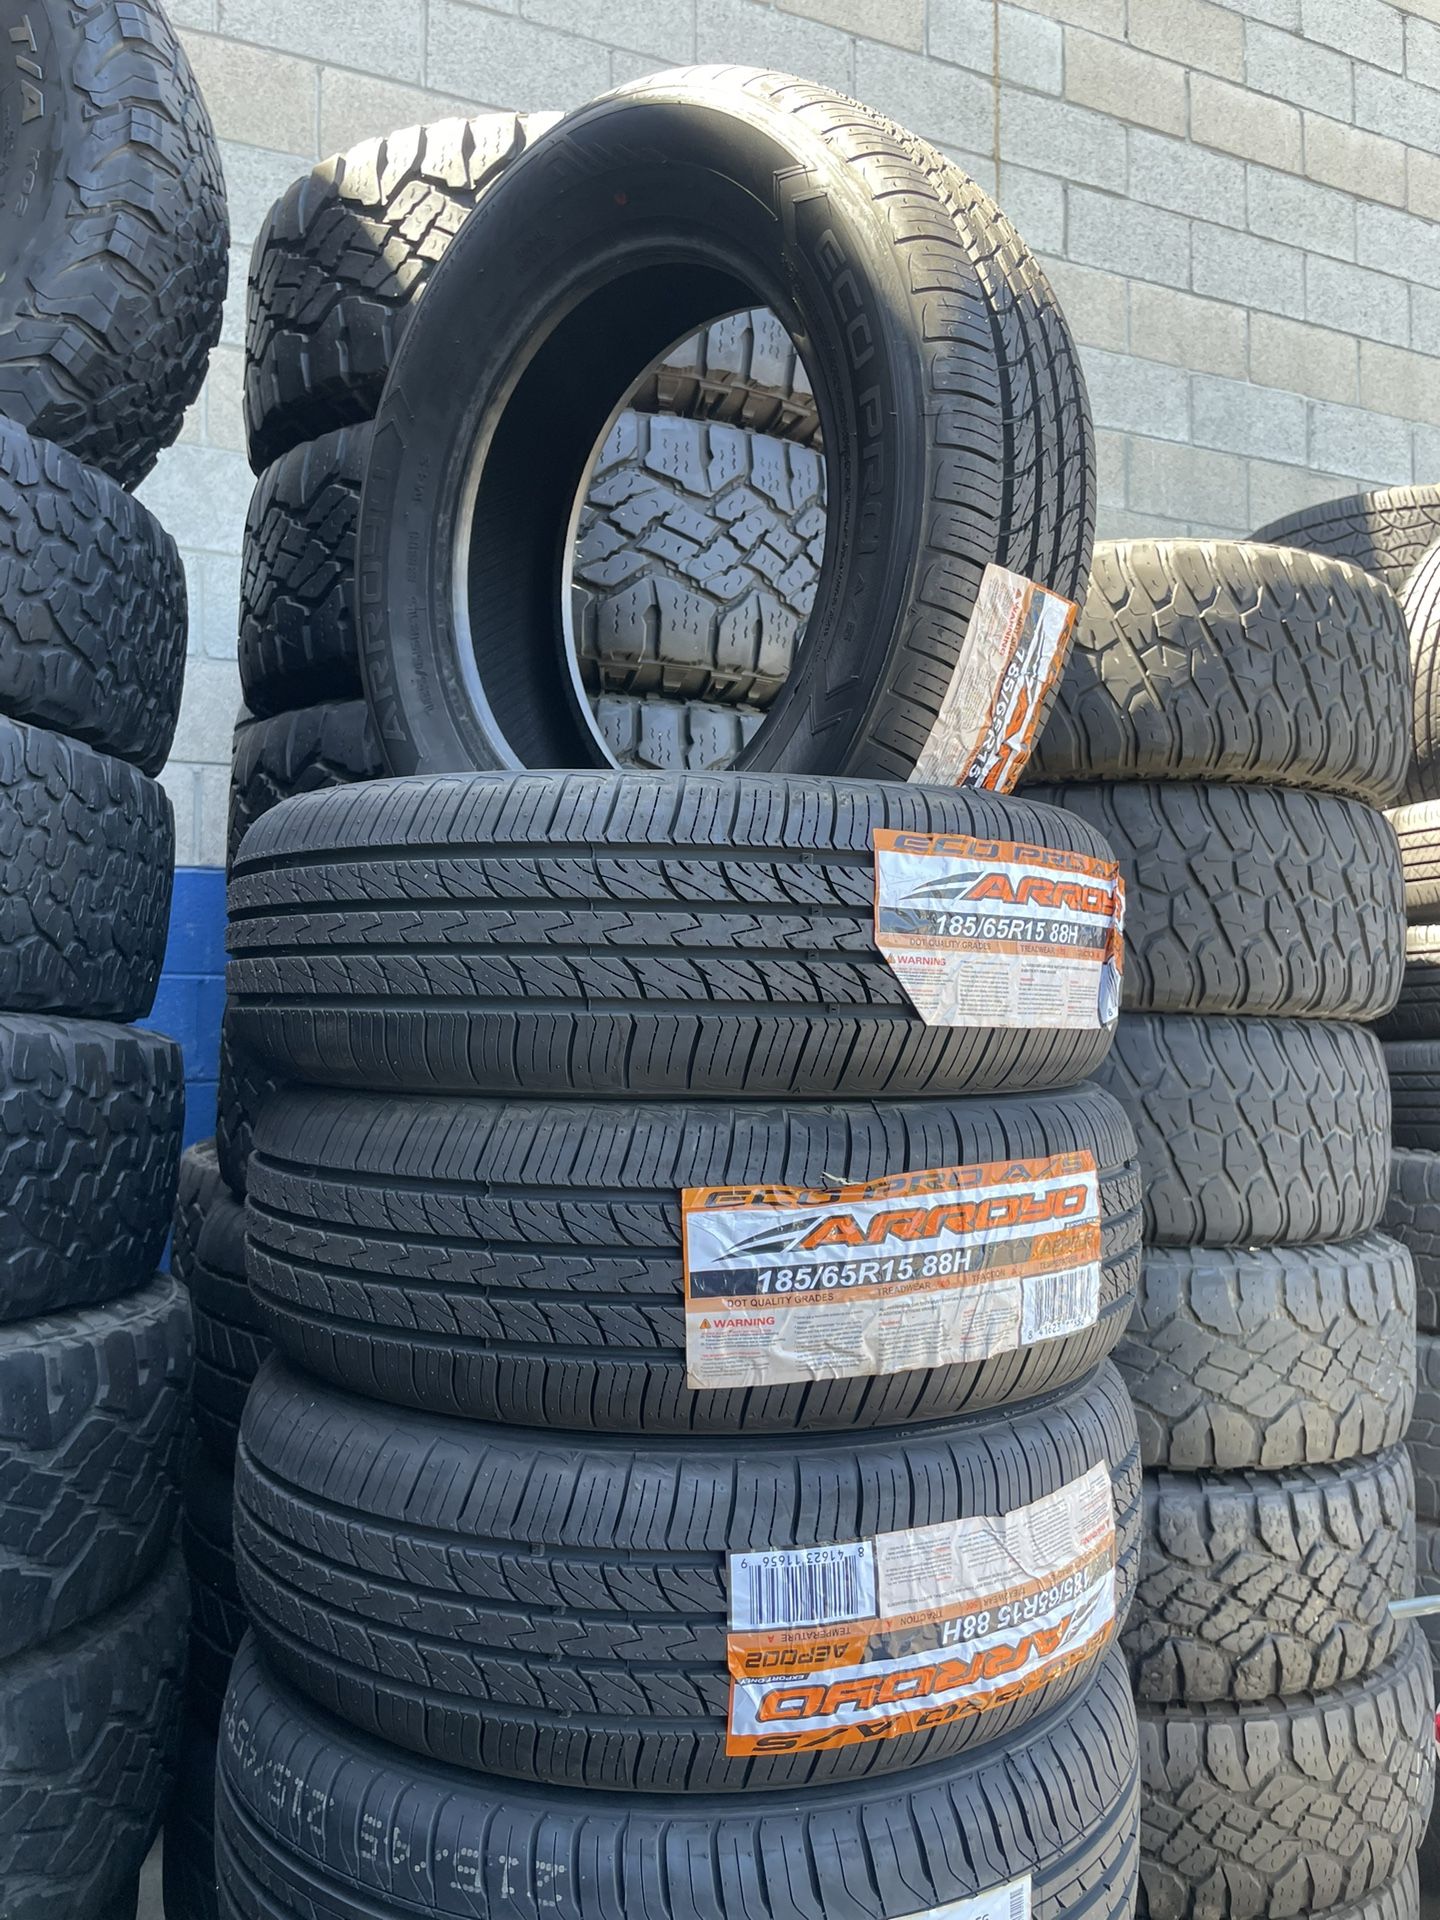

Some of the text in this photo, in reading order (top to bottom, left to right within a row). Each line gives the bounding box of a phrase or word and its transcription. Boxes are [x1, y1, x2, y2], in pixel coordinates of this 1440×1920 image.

[8, 14, 44, 125] T/A
[813, 228, 875, 370] ECO
[363, 467, 408, 741] ARROYO
[999, 600, 1023, 656] WARNING
[968, 647, 1028, 778] 185/65R15
[894, 834, 998, 858] ECO
[935, 914, 1079, 945] 185/65R15 88H
[910, 938, 991, 952] DOT QUALITY GRADES
[897, 955, 946, 966] WARNING
[793, 1184, 1088, 1251] ARROYO
[758, 1250, 971, 1293] 185/65R15 88H
[727, 1292, 834, 1309] DOT QUALITY GRADES
[876, 1281, 931, 1297] TREADWEAR
[713, 1316, 775, 1328] WARNING
[741, 1547, 864, 1570] 8 41623 11656 9
[998, 1566, 1089, 1628] 185/65R15
[901, 1610, 943, 1626] TRACTION
[943, 1611, 990, 1645] 88H
[767, 1627, 850, 1643] TEMPERATURE A
[745, 1642, 850, 1669] AEP002
[755, 1615, 1073, 1723] ARROYO
[739, 1674, 806, 1687] EXPORT ONLY
